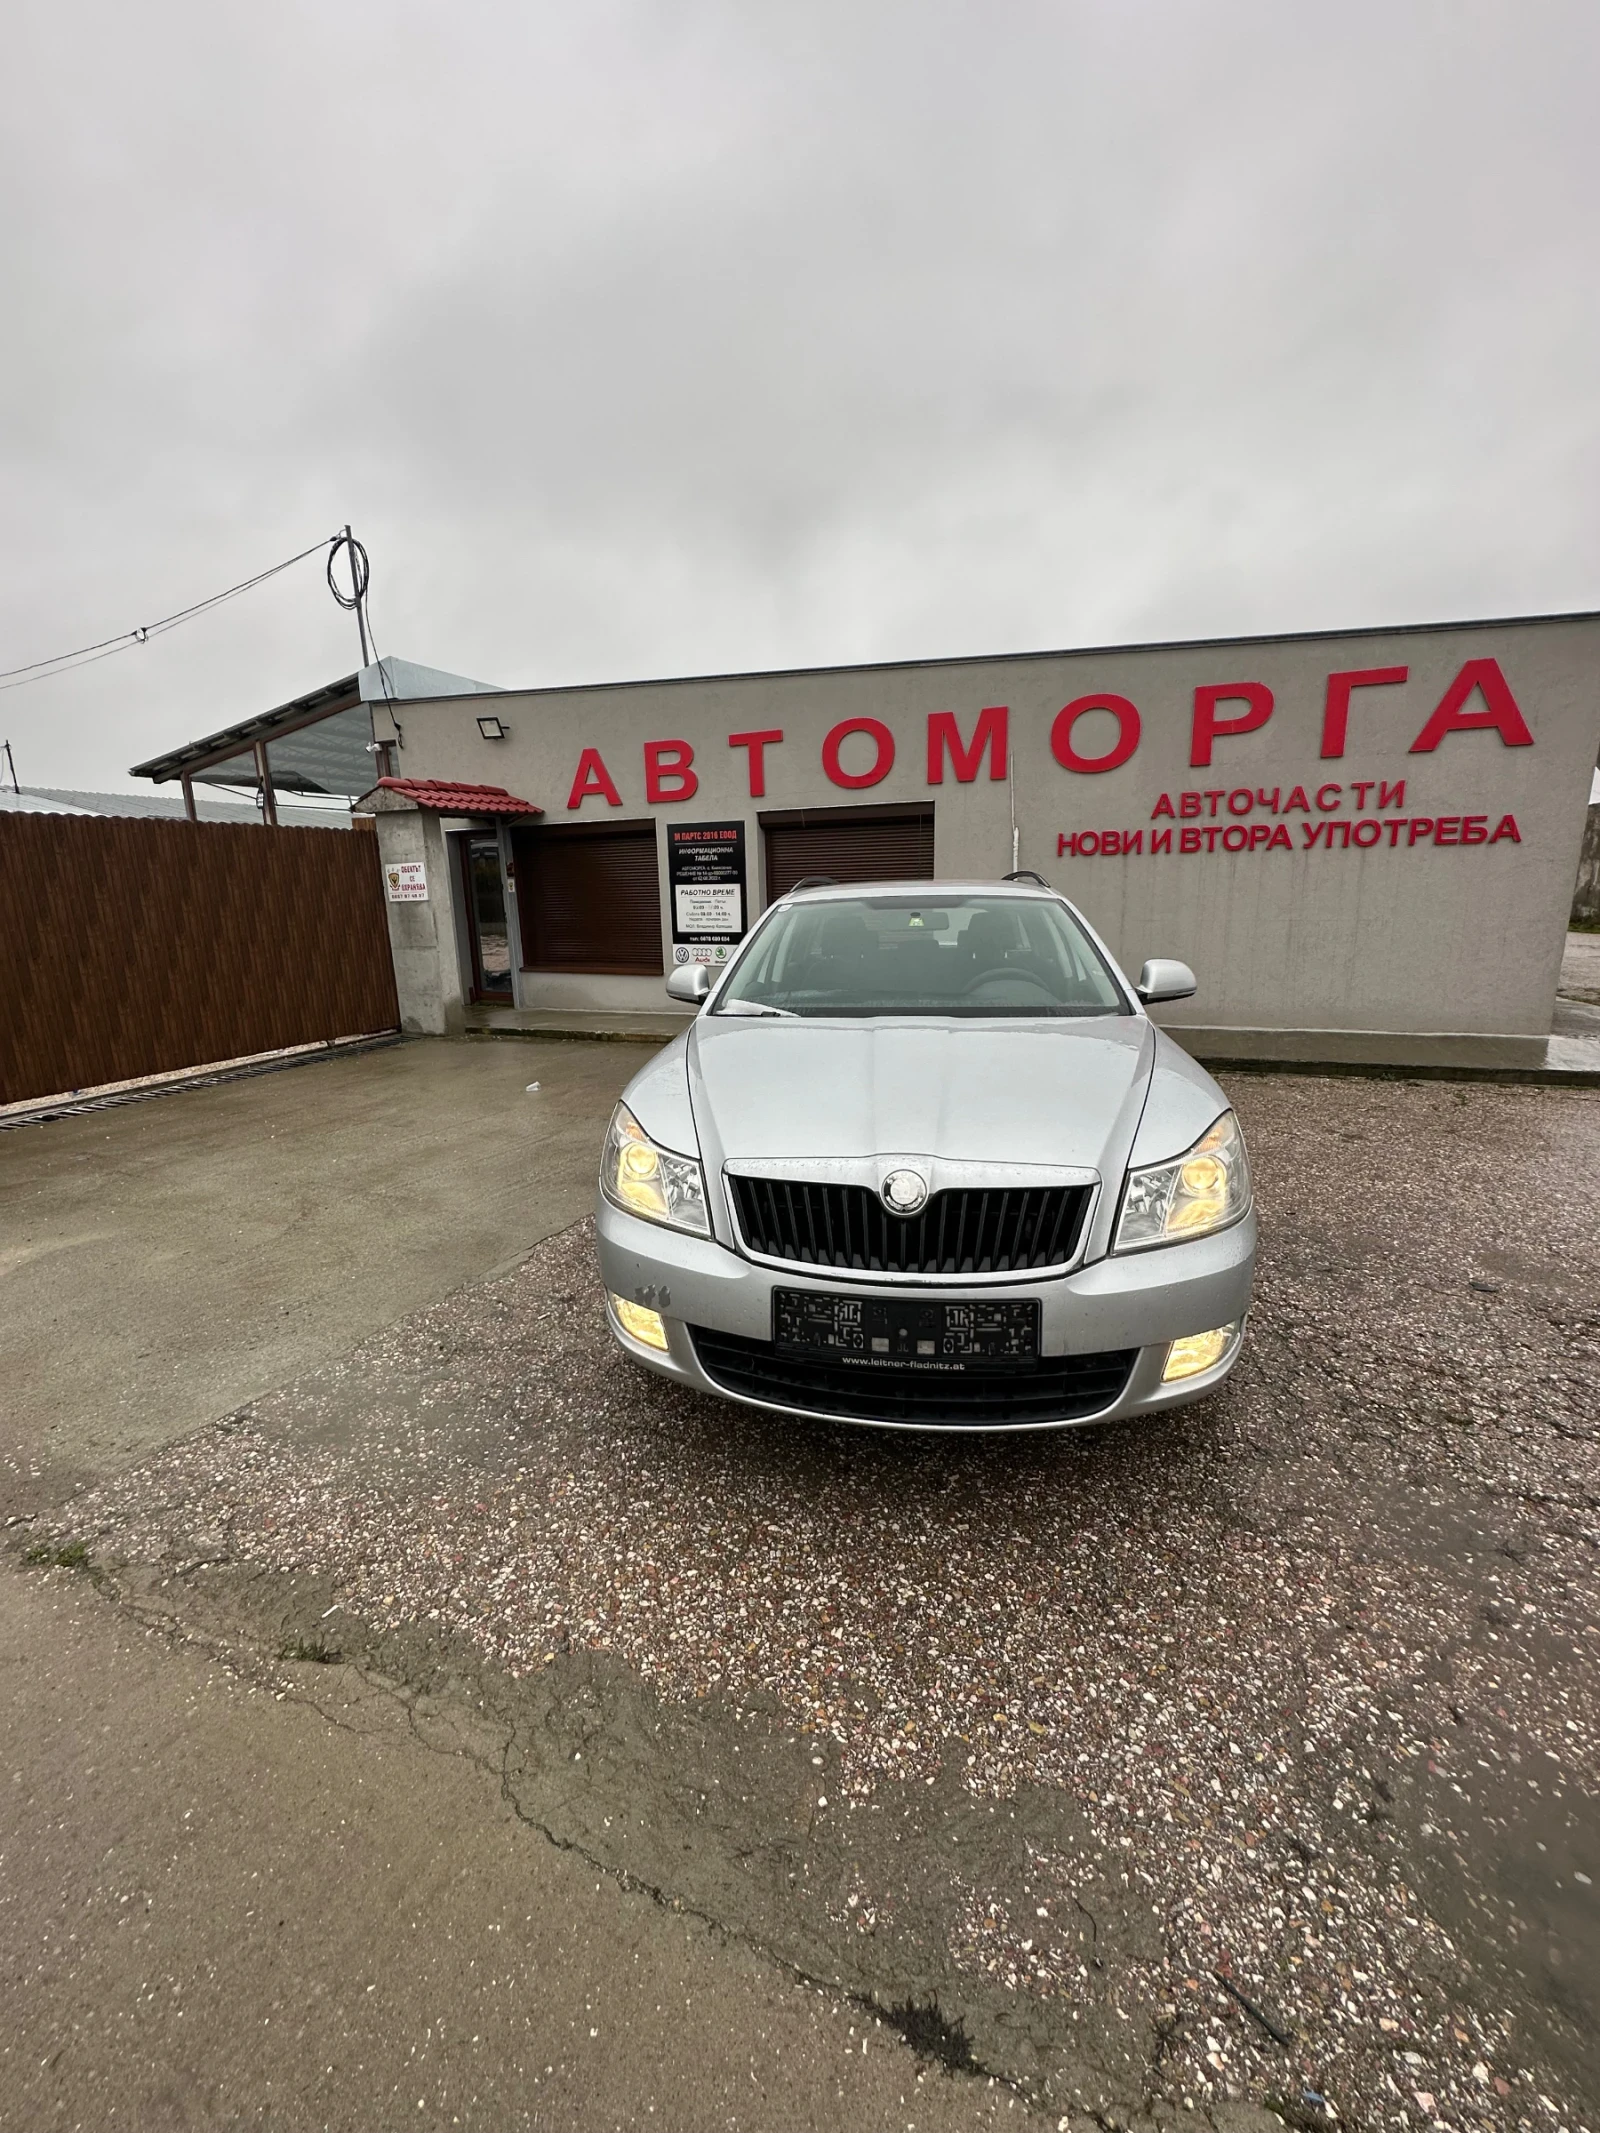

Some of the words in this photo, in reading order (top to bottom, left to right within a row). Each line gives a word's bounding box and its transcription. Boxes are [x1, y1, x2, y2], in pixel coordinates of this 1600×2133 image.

[567, 658, 1534, 809] АВТОМОРГА
[1152, 779, 1407, 819] АВТОЧАСТИ
[681, 831, 702, 840] ПАРТС
[702, 831, 719, 840] 2016
[719, 829, 737, 839] ЕООД
[1057, 829, 1144, 856] НОВИ
[1151, 827, 1173, 854] И
[1180, 823, 1293, 853] ВТОРА
[1303, 814, 1522, 850] УПОТРЕБА
[678, 847, 733, 855] ИНФОРМАЦИОННА
[694, 854, 718, 862] ТАБЕЛА
[401, 865, 421, 873] ОБЕКТЪТ
[401, 883, 425, 891] ОХРАНЯВА
[842, 1356, 966, 1371] www.leitner-fladnitz.at
